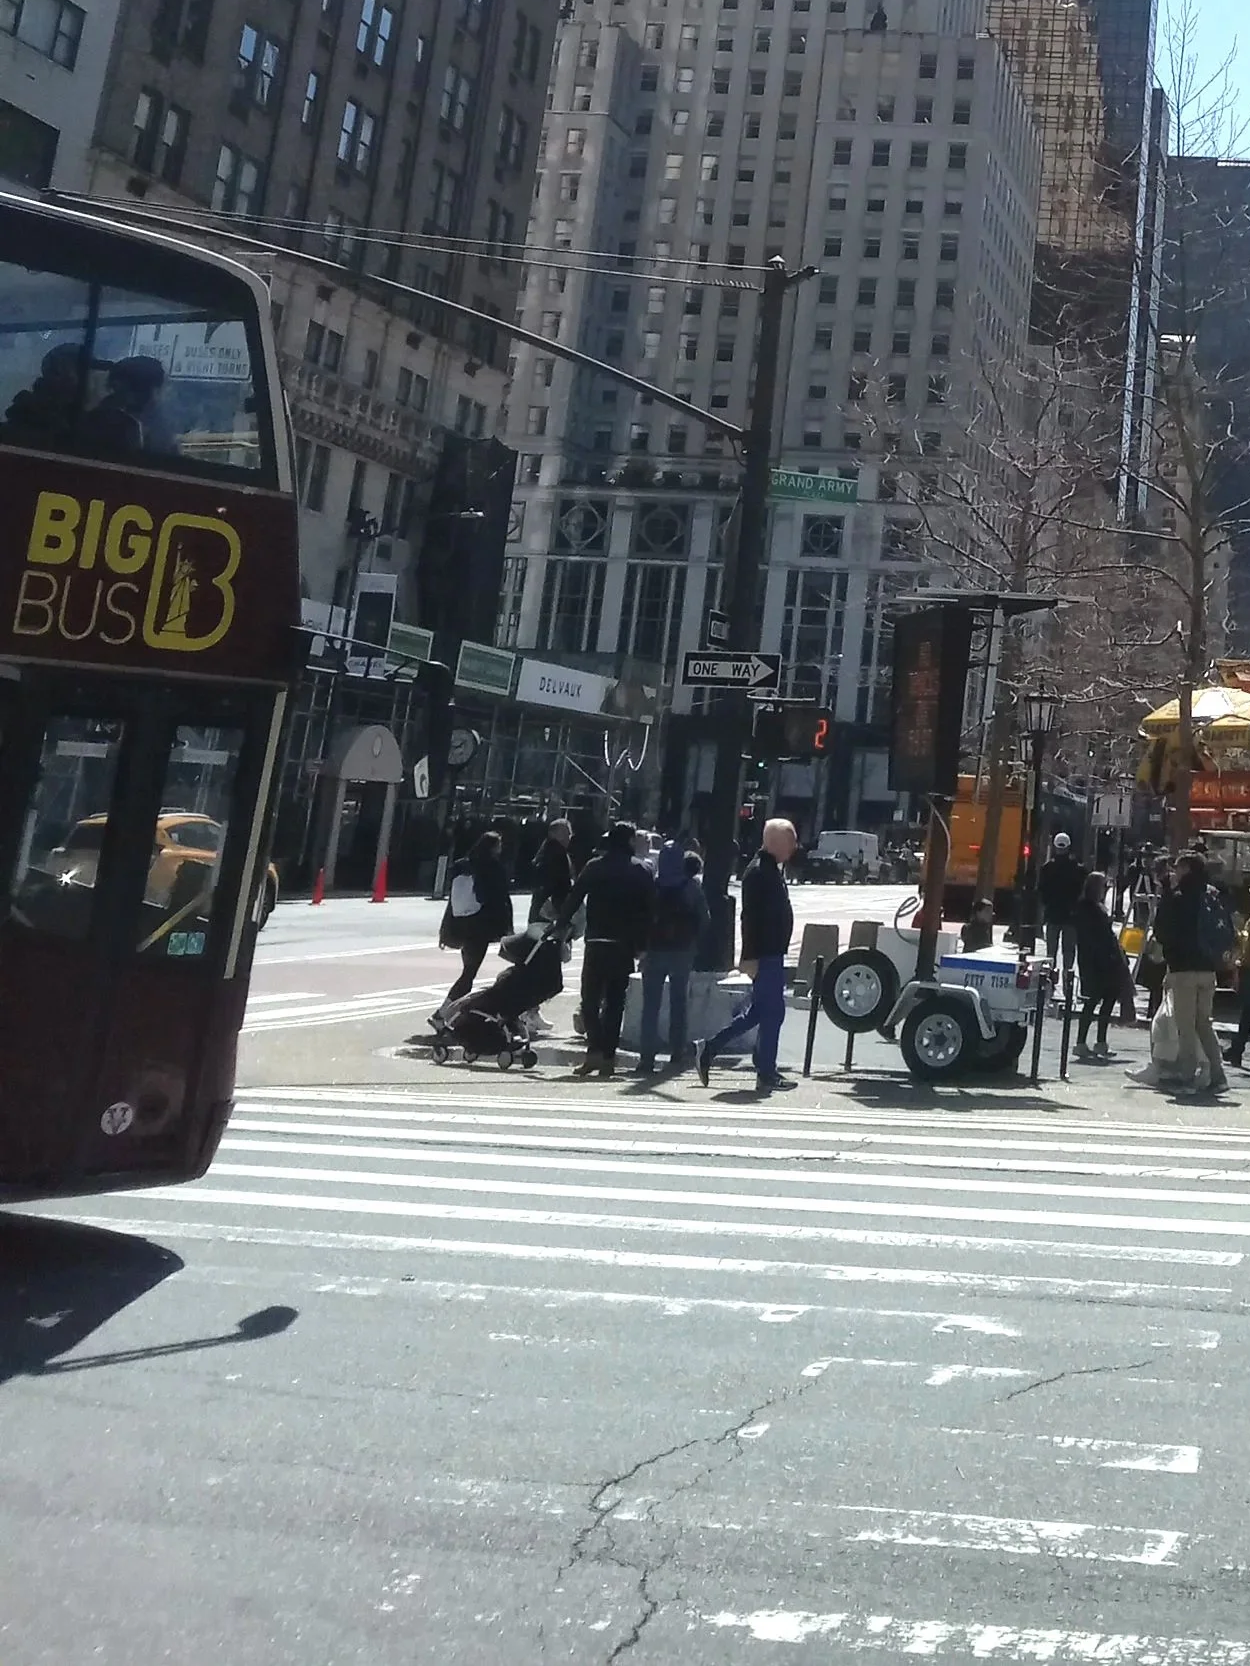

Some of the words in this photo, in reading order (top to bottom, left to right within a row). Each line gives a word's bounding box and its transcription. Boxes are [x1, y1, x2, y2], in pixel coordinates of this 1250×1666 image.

[219, 346, 242, 359] ONLY
[217, 362, 249, 375] TURNS
[771, 473, 814, 490] GRAND
[818, 480, 854, 494] ARMY
[27, 491, 154, 574] BIG
[12, 569, 140, 645] BUS
[692, 662, 718, 676] ONE
[731, 664, 761, 678] WAY
[538, 676, 583, 698] DELVAUX
[814, 719, 828, 749] 2
